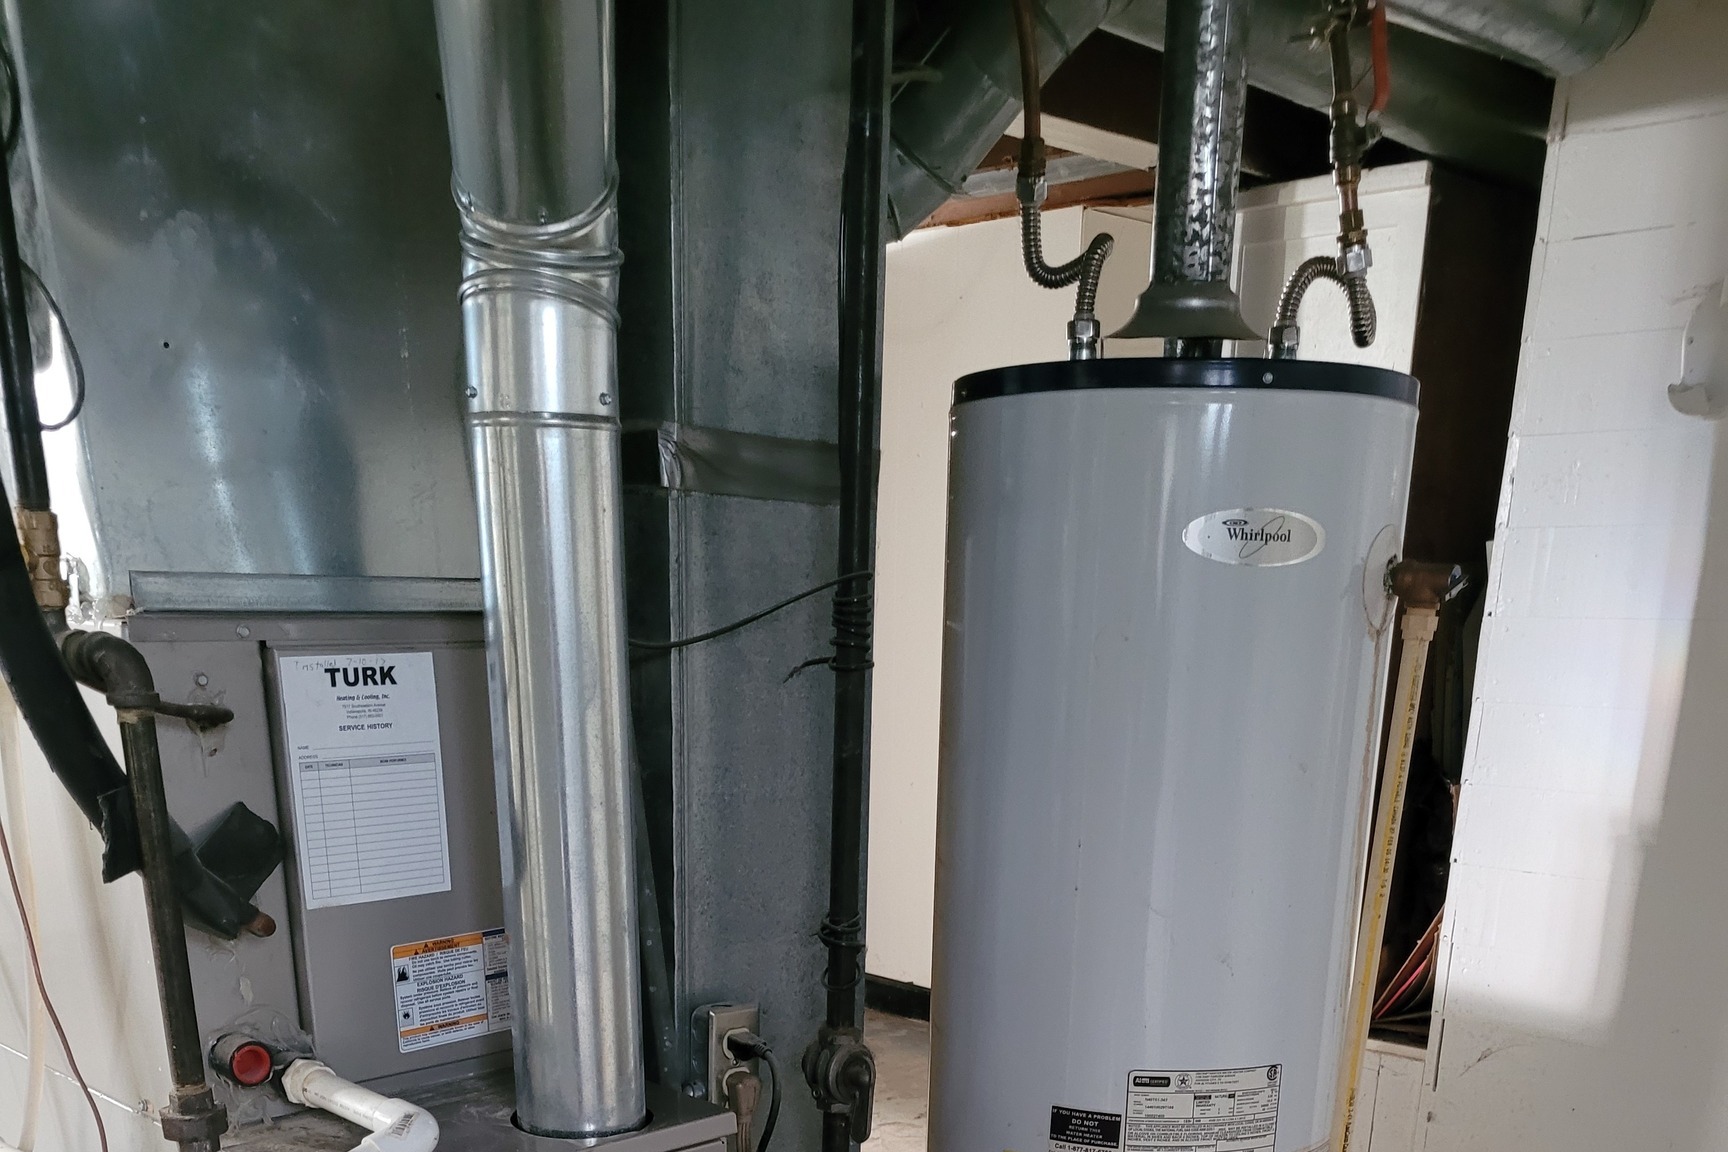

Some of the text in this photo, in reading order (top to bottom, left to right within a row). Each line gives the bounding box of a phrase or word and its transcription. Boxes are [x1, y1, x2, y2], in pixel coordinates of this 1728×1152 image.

[1227, 527, 1291, 545] Whirlpool
[324, 666, 397, 687] TURK
[417, 978, 443, 987] EXPLOSION
